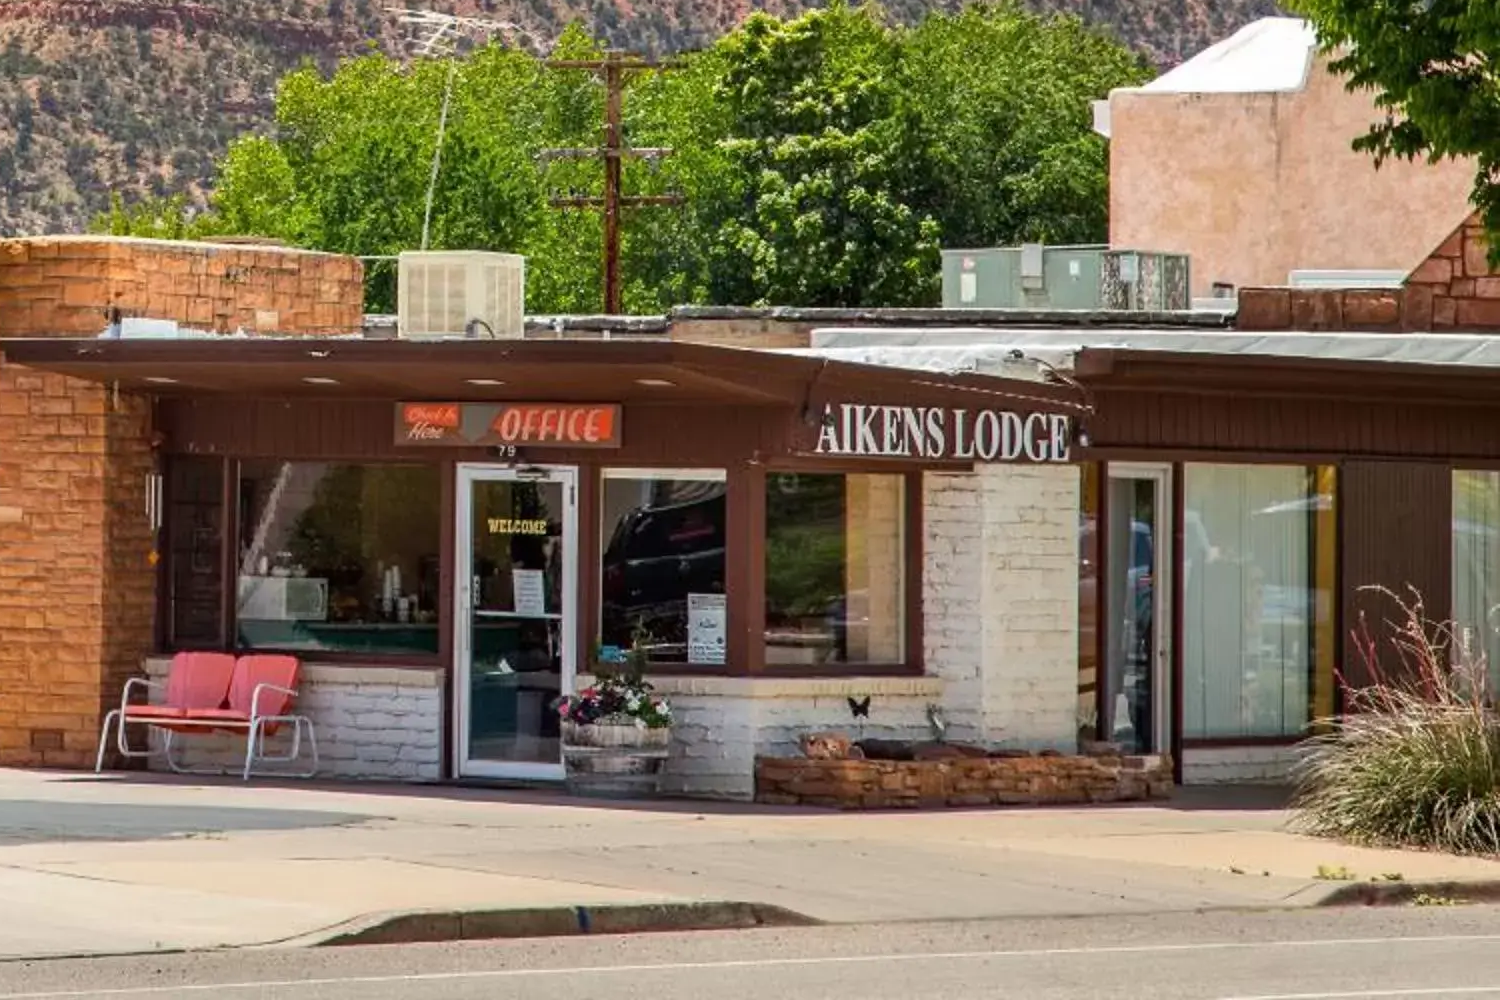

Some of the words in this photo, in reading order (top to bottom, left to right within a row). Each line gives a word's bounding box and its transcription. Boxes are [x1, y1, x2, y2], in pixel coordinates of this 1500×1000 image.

[500, 407, 605, 442] OFFICE
[814, 402, 946, 458] AIKENS
[952, 408, 1070, 462] LODGE
[499, 444, 516, 457] 79
[487, 518, 548, 535] WELCOME
